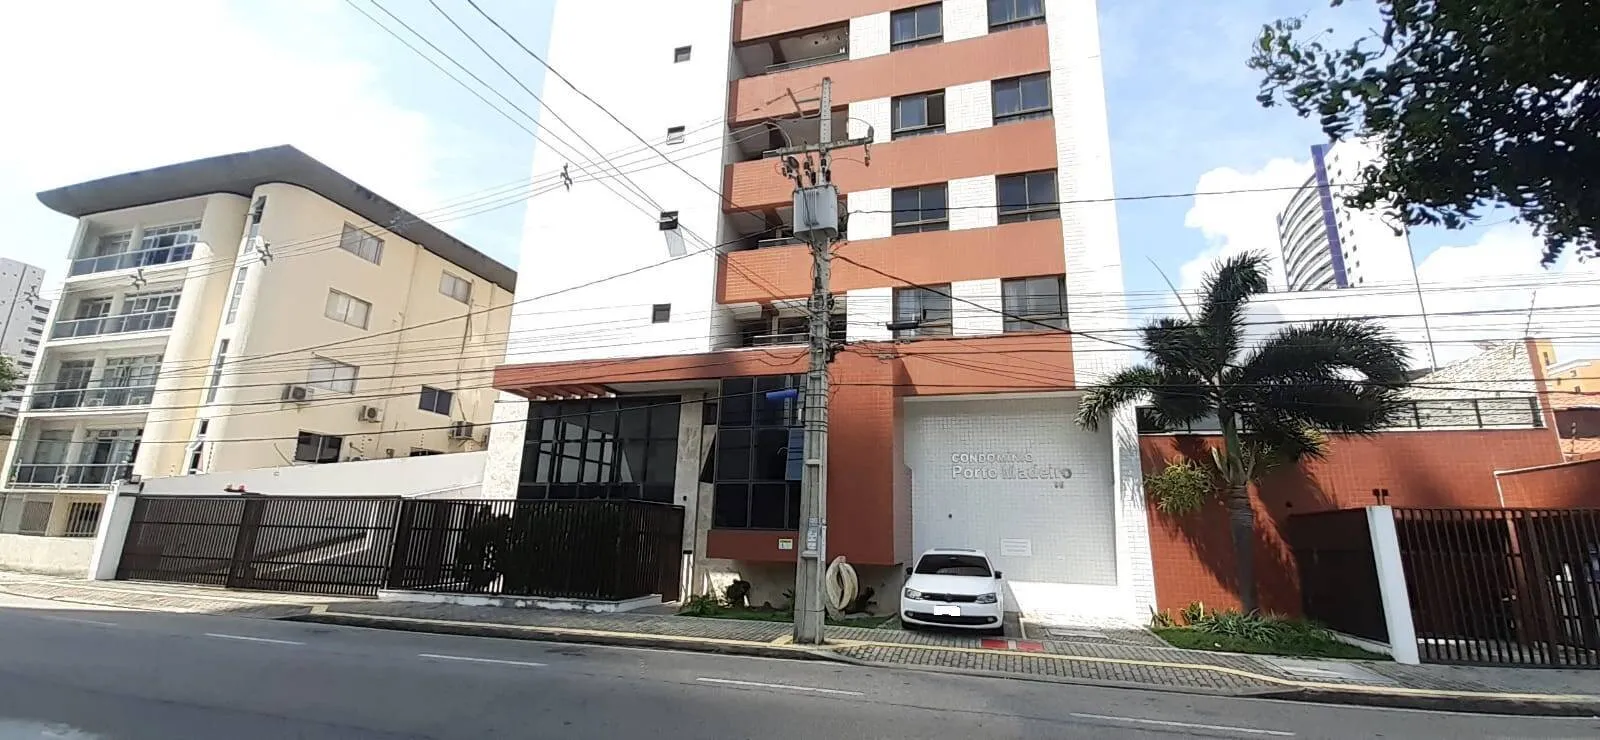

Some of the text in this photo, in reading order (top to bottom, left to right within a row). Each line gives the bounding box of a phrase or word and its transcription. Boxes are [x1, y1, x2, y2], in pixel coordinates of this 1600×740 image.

[951, 452, 1033, 463] CONDOMINO
[951, 465, 1073, 480] Porto Madeiro
